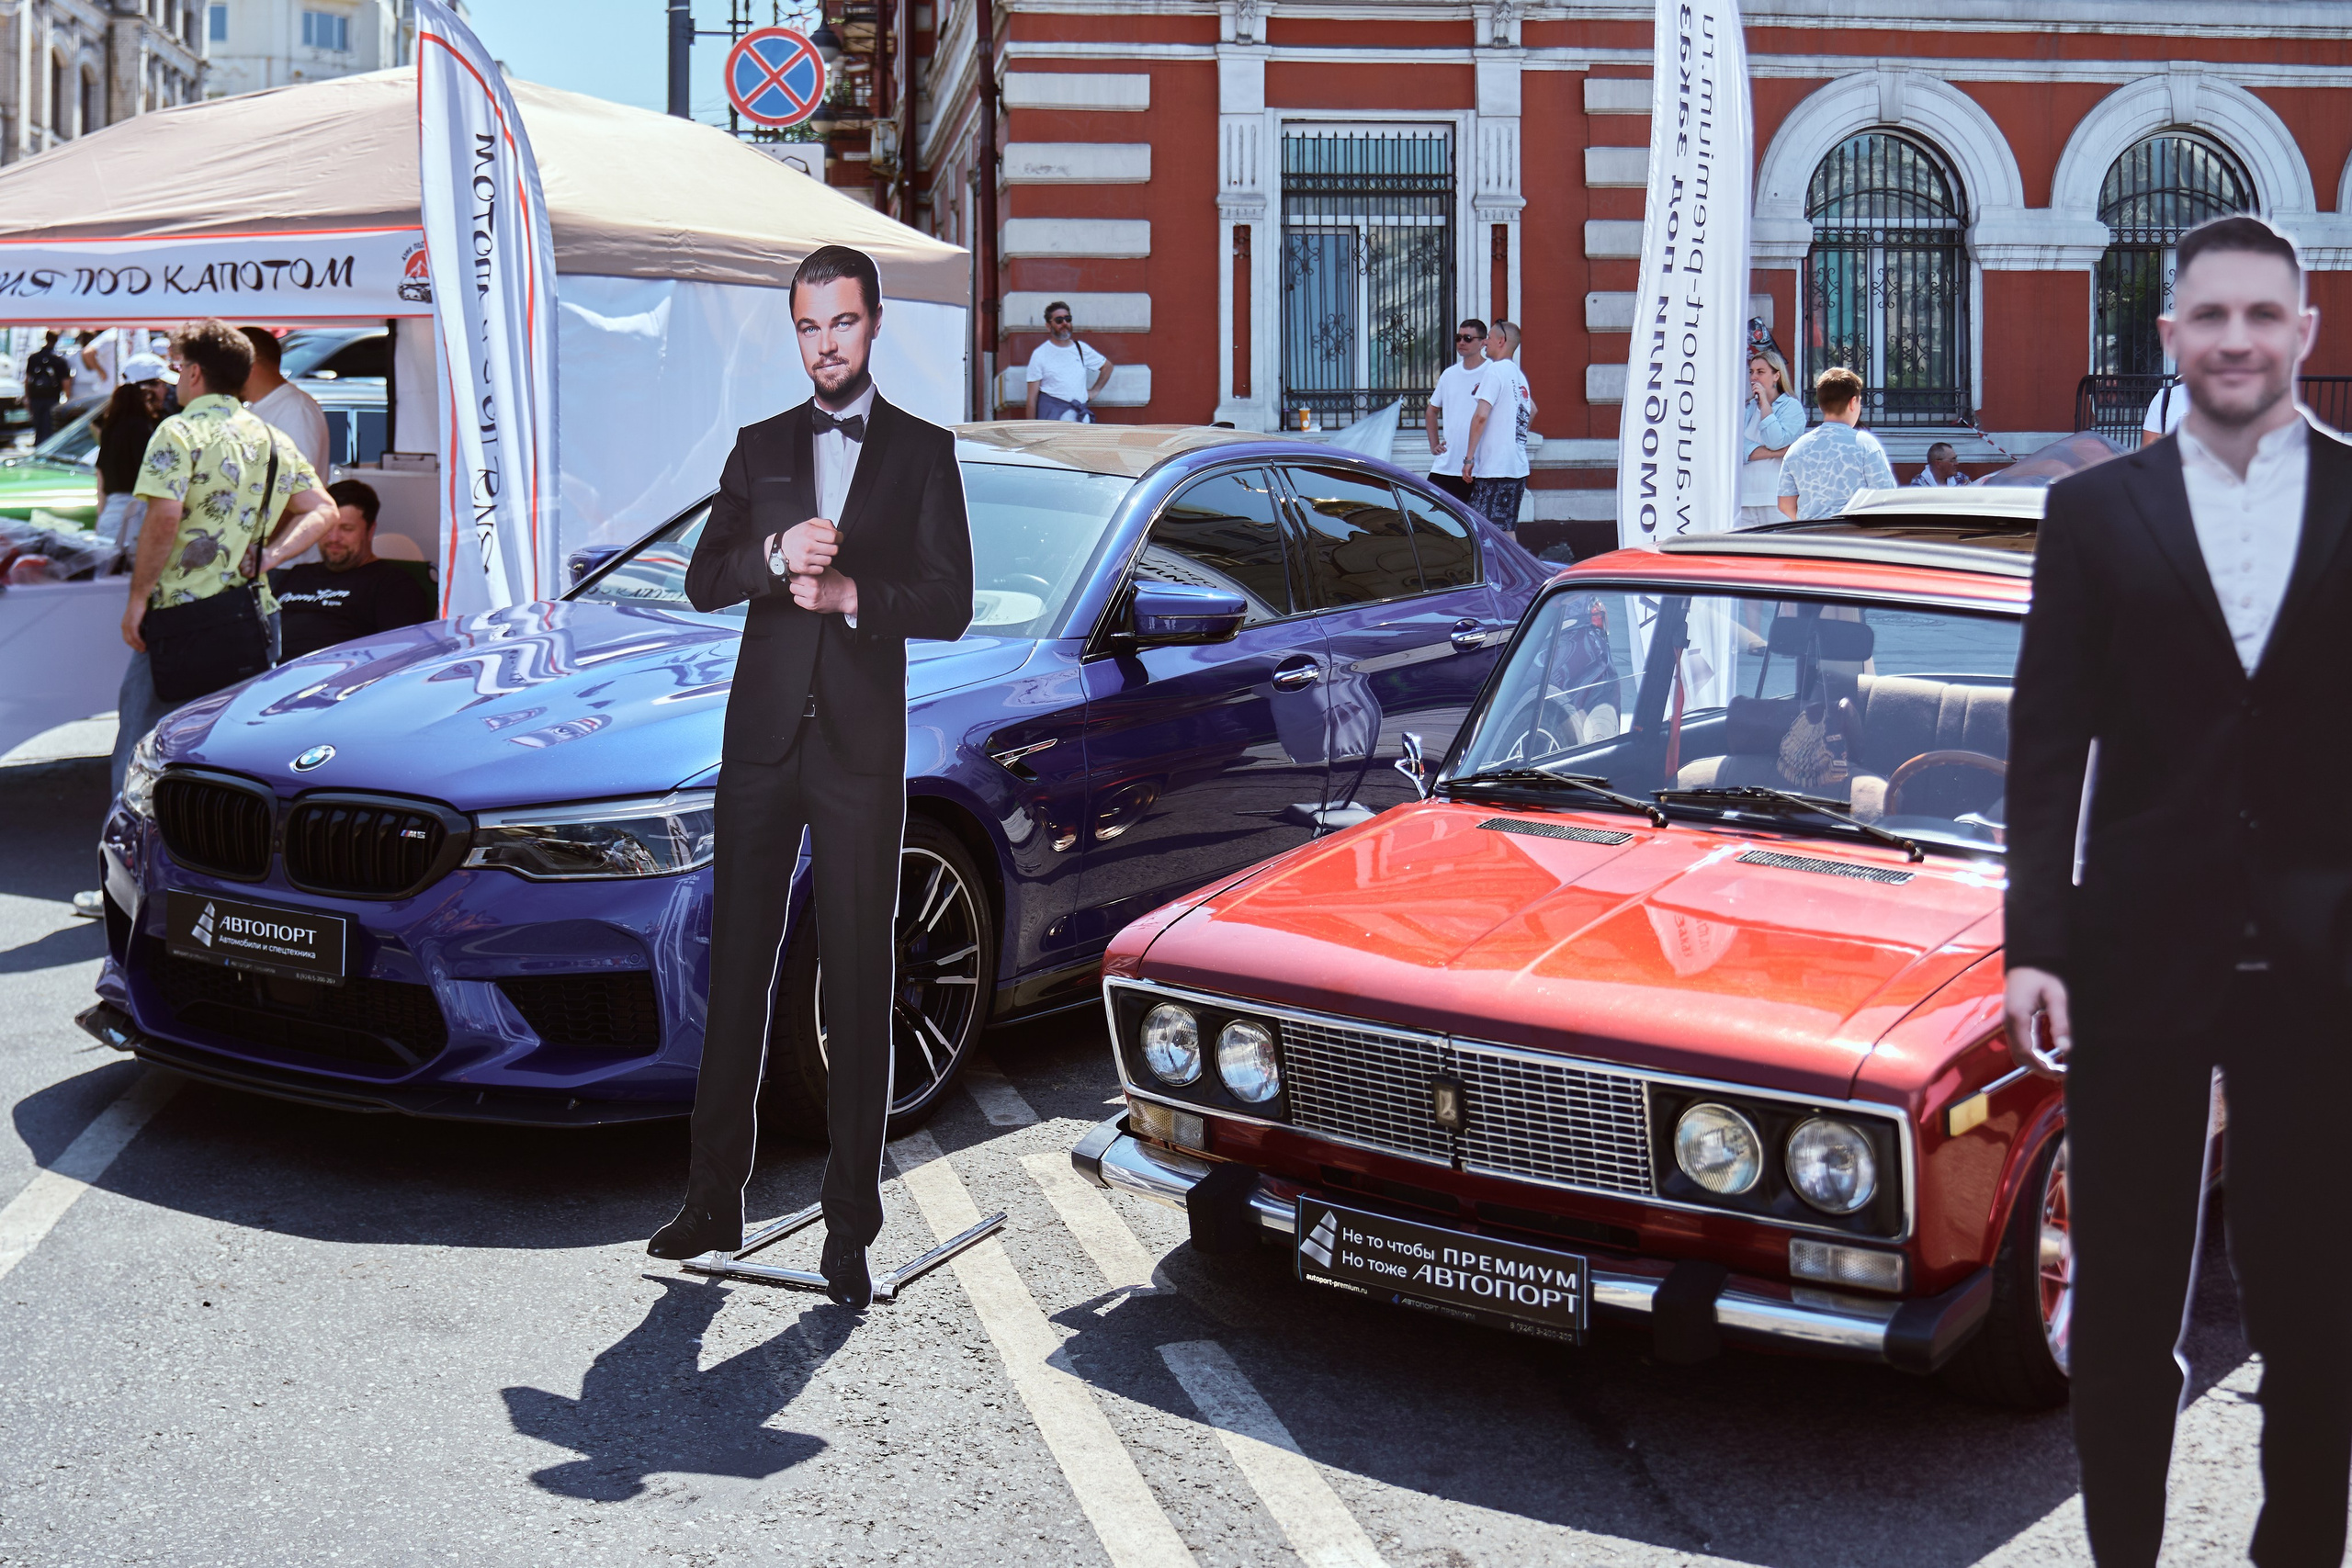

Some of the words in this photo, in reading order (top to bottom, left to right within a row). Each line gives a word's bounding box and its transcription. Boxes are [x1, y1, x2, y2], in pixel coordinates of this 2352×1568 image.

[0, 268, 68, 298] ИЯ
[72, 266, 151, 297] ПОД
[164, 254, 356, 295] КАПОТОМ
[219, 915, 317, 945] АВТОПОРТ
[219, 934, 262, 951] Автомобили
[262, 943, 268, 952] и
[268, 944, 316, 960] спецтехника
[1342, 1226, 1363, 1245] Не
[1366, 1235, 1384, 1249] то
[1386, 1239, 1435, 1261] чтобы
[1443, 1247, 1577, 1290] ПРЕМИУМ
[1306, 1273, 1368, 1294] autoport-premium.ru
[1341, 1250, 1363, 1268] Но
[1367, 1258, 1408, 1279] тоже
[1412, 1263, 1580, 1314] АВТОПОРТ
[1401, 1297, 1440, 1312] АВТОПОРТ
